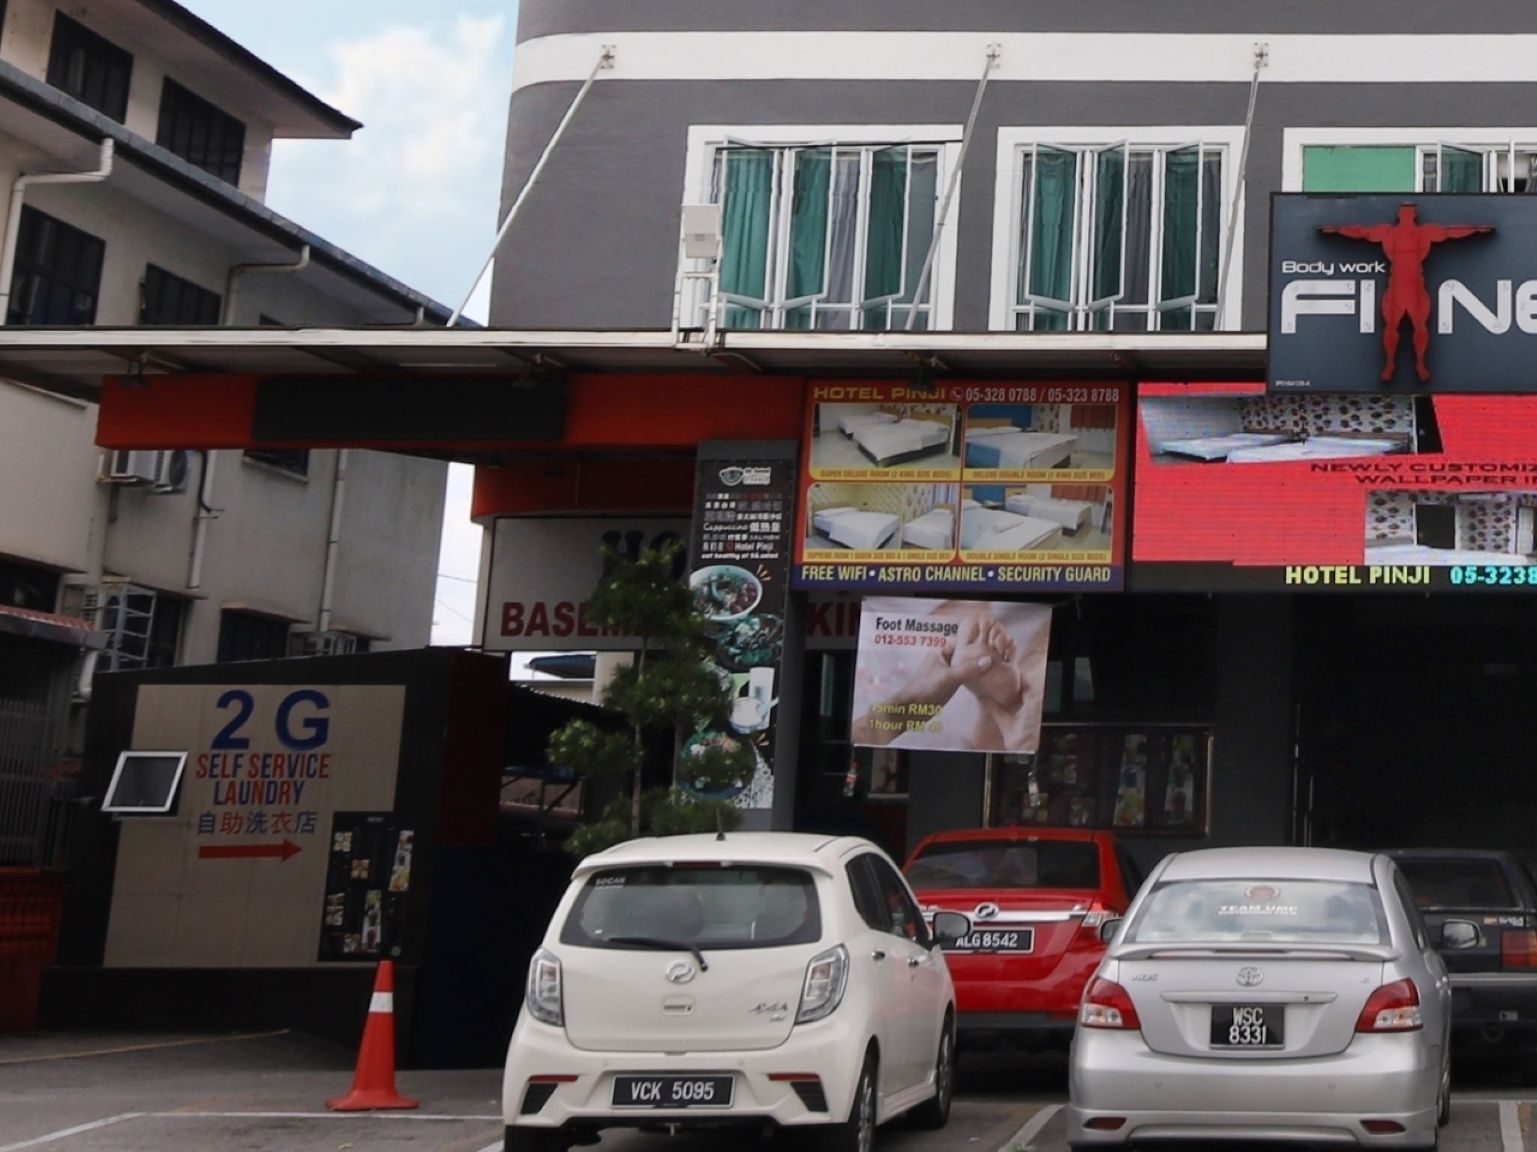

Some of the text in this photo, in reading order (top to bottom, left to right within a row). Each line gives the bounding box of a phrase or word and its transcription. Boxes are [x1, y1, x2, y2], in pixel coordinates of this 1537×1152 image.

[1282, 260, 1386, 276] Body work
[814, 387, 884, 399] HOTEL
[891, 387, 946, 399] PINJI
[1008, 388, 1039, 402] 0788
[1048, 388, 1088, 402] 05-323
[1090, 388, 1119, 402] 8788
[1310, 462, 1402, 472] NEWLY
[1355, 475, 1517, 485] WALLPAPER
[801, 566, 1111, 581] FREE WIFI ASTRO CHANNEL SECURITY GUARD
[1285, 567, 1362, 585] HOTEL
[1369, 567, 1430, 585] PINJI
[876, 617, 902, 630] Foot
[905, 618, 959, 637] Massage
[196, 753, 331, 778] SELF SERVICE
[214, 780, 306, 805] LAUNDRY
[197, 811, 319, 835] 自助洗衣店
[1232, 1006, 1264, 1026] WSC
[1228, 1025, 1267, 1045] 8331
[630, 1080, 715, 1101] VCK 5095
